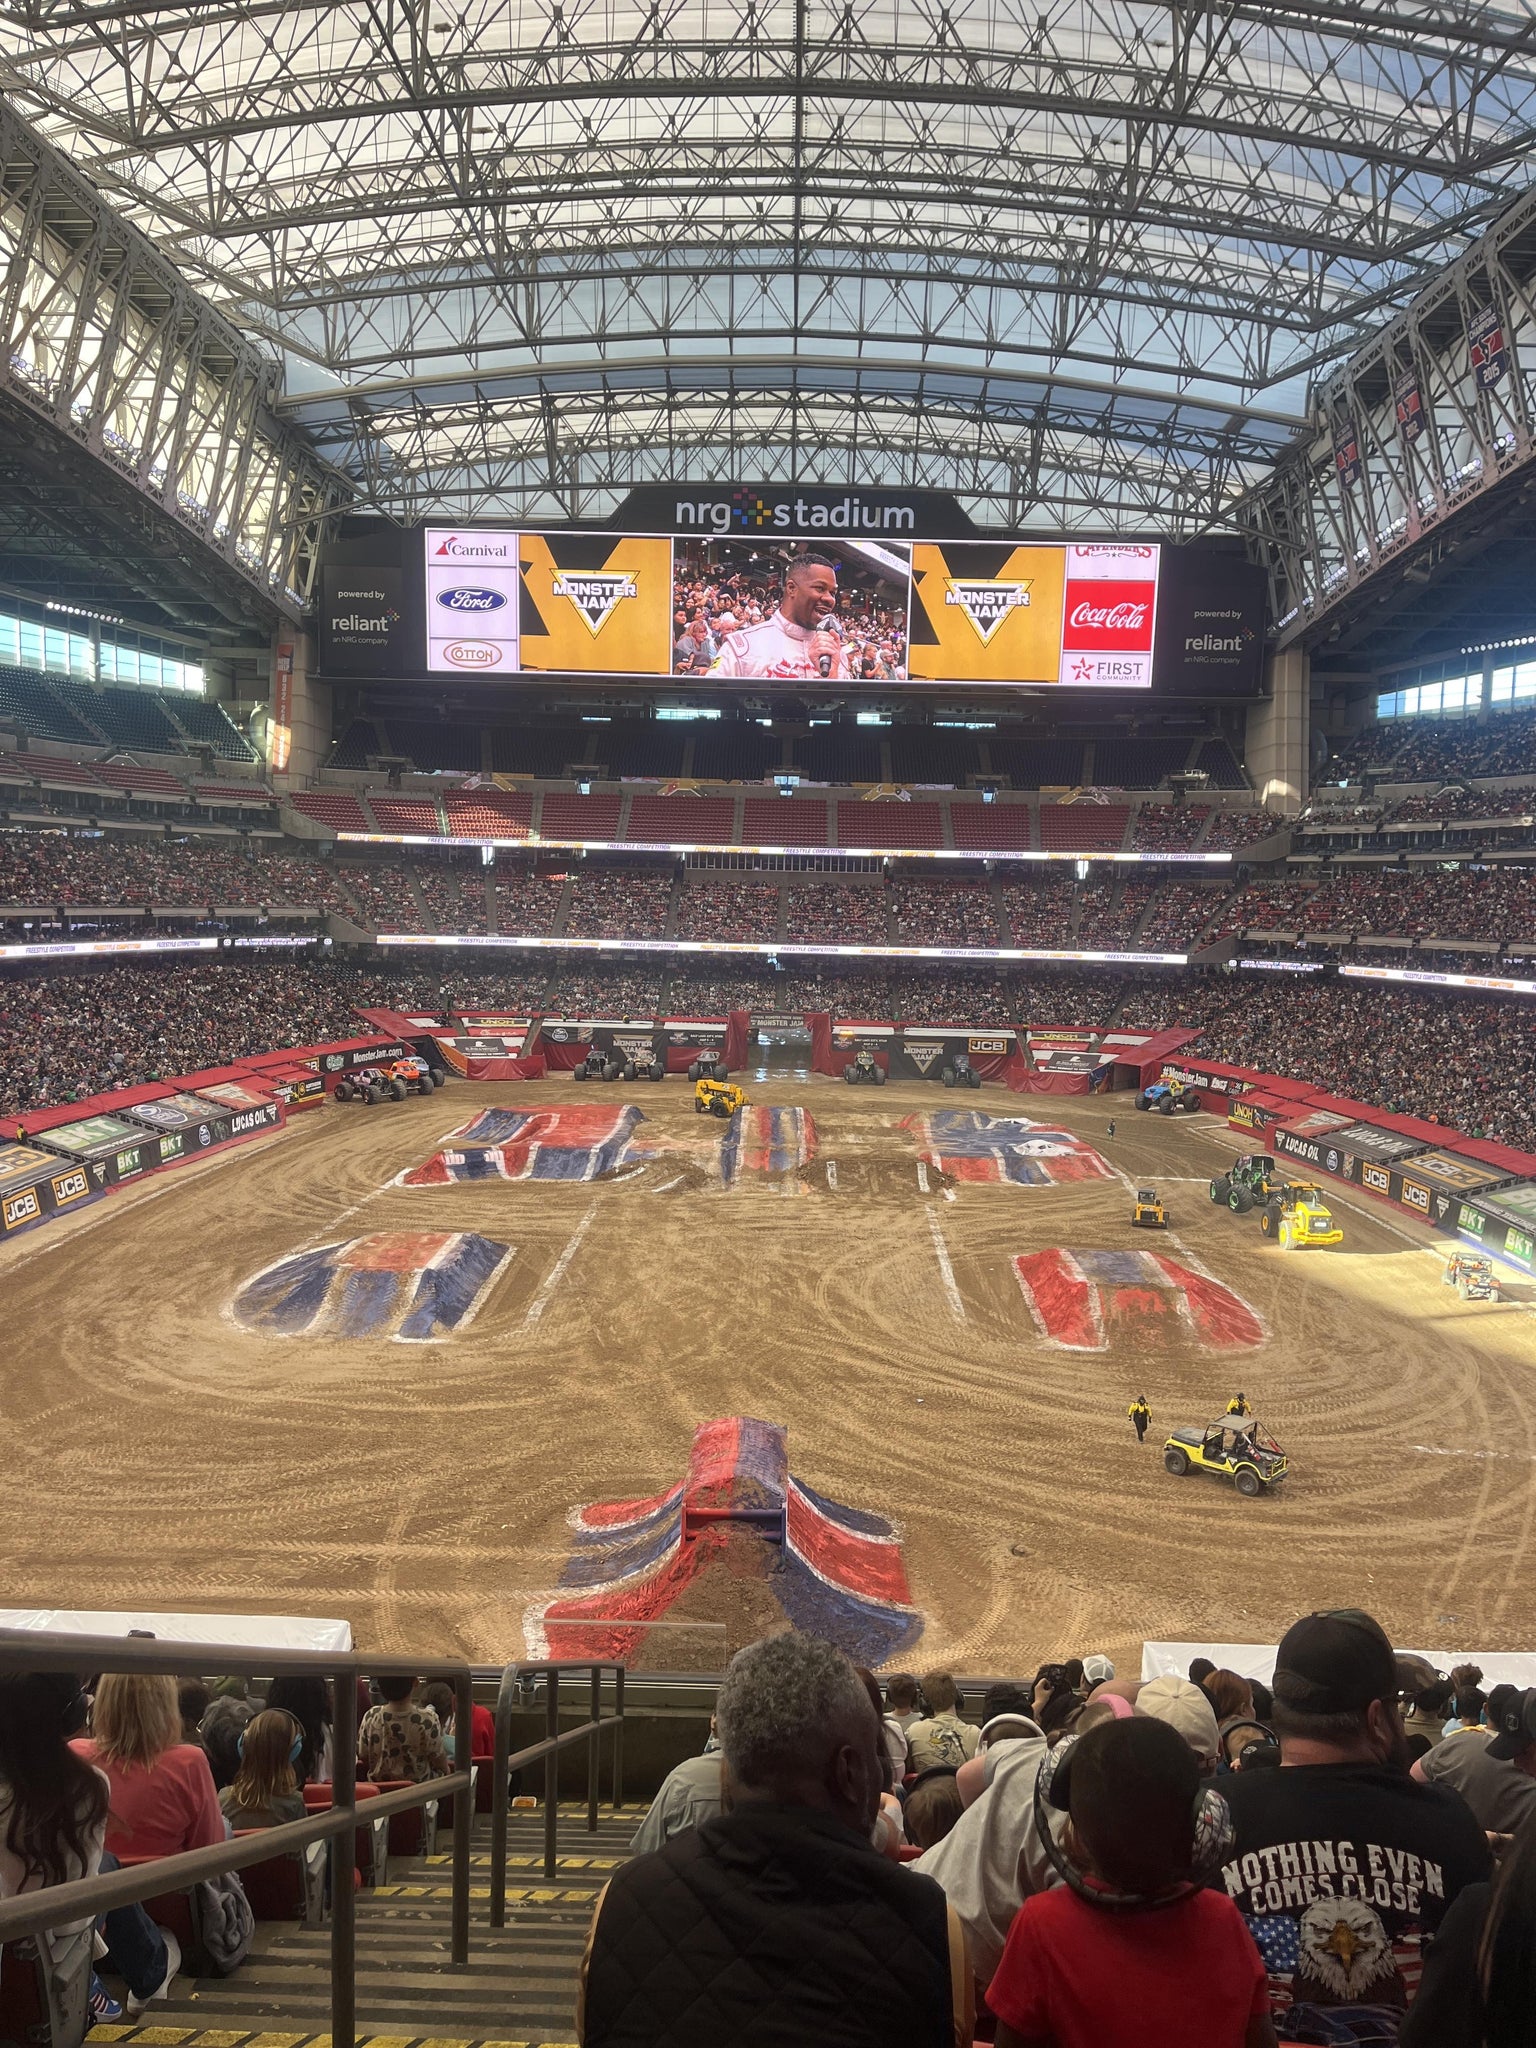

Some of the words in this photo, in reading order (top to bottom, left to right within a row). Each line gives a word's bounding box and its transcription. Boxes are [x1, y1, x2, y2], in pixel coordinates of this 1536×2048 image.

[1469, 312, 1497, 340] CHAMPIONS
[1483, 361, 1500, 384] 2015
[676, 501, 731, 534] nrg
[773, 498, 915, 529] stadium
[452, 543, 508, 558] Carnival
[338, 590, 375, 600] powered
[375, 590, 385, 601] by
[552, 582, 637, 598] MONSTER
[946, 591, 1030, 606] MONSTER
[450, 590, 493, 610] Ford
[574, 596, 615, 610] JAM
[968, 605, 1007, 619] JAM
[1070, 602, 1149, 629] Coca-Cola
[1194, 610, 1230, 619] powered
[1231, 610, 1242, 620] by
[332, 615, 389, 632] reliant
[341, 636, 356, 644] NRG
[357, 638, 389, 646] company
[1185, 635, 1242, 651] reliant
[1097, 662, 1143, 676] FIRST
[1208, 657, 1241, 665] company
[613, 1039, 653, 1047] MONSTER
[903, 1047, 944, 1055] MONSTER
[971, 1041, 1004, 1051] JCB
[353, 1047, 403, 1064] MonsterJam.com
[1162, 1066, 1208, 1087] #MonsterJam
[1233, 1103, 1254, 1120] UNOH
[231, 1112, 254, 1133] LUCAS
[254, 1109, 267, 1125] OIL
[41, 1119, 119, 1149] BKT
[1341, 1128, 1388, 1146] LUCAS
[160, 1135, 183, 1153] BKT
[1285, 1136, 1307, 1157] LUCAS
[1307, 1144, 1320, 1161] OIL
[117, 1149, 140, 1170] BKT
[1413, 1158, 1461, 1176] JCB
[57, 1173, 86, 1199] JCB
[1364, 1168, 1388, 1189] JCB
[1404, 1186, 1428, 1207] JCB
[7, 1194, 37, 1222] JCB
[1458, 1208, 1486, 1230] BKT
[1506, 1231, 1533, 1255] BKT
[1221, 1840, 1358, 1898] NOTHING
[1366, 1843, 1445, 1899] EVEN
[1251, 1874, 1335, 1915] COMES
[1342, 1874, 1421, 1915] CLOSE
